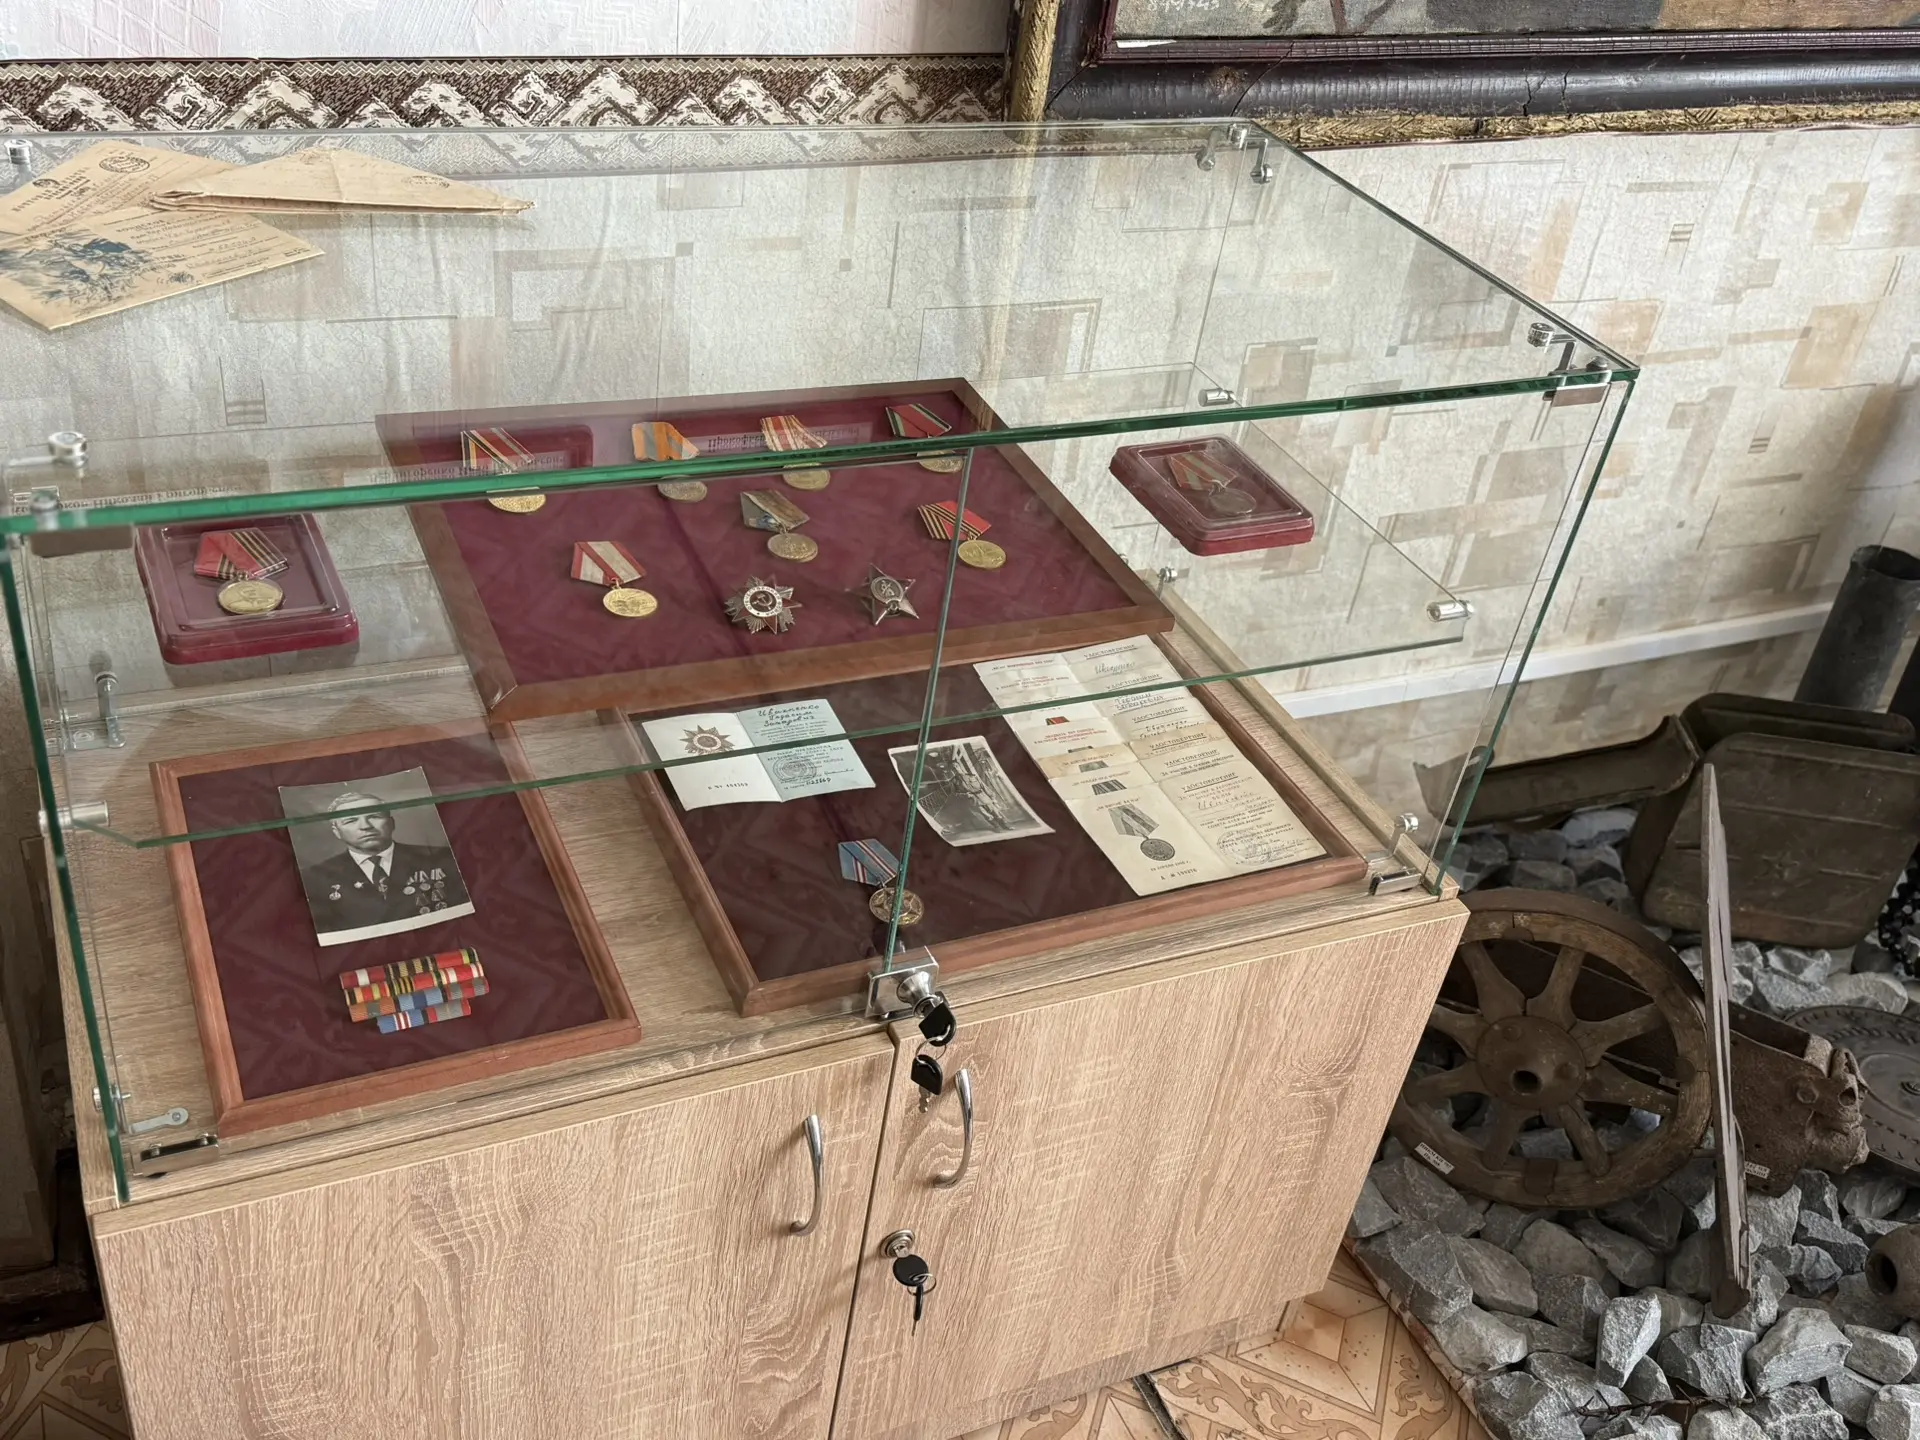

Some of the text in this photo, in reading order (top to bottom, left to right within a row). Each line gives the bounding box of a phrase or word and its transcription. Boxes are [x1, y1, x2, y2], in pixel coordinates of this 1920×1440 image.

[1083, 644, 1136, 658] УДОСТОВЕРЕНИЕ
[1106, 673, 1160, 689] УДОСТОВЕРЕНИЕ
[1131, 706, 1186, 722] УДОСТОВЕРЕНИЕ
[1149, 733, 1204, 749] УДОСТОВЕРЕНИЕ
[1164, 749, 1218, 766] УДОСТОВЕРЕНИЕ
[1181, 772, 1236, 790] УДОСТОВЕРЕНИЕ
